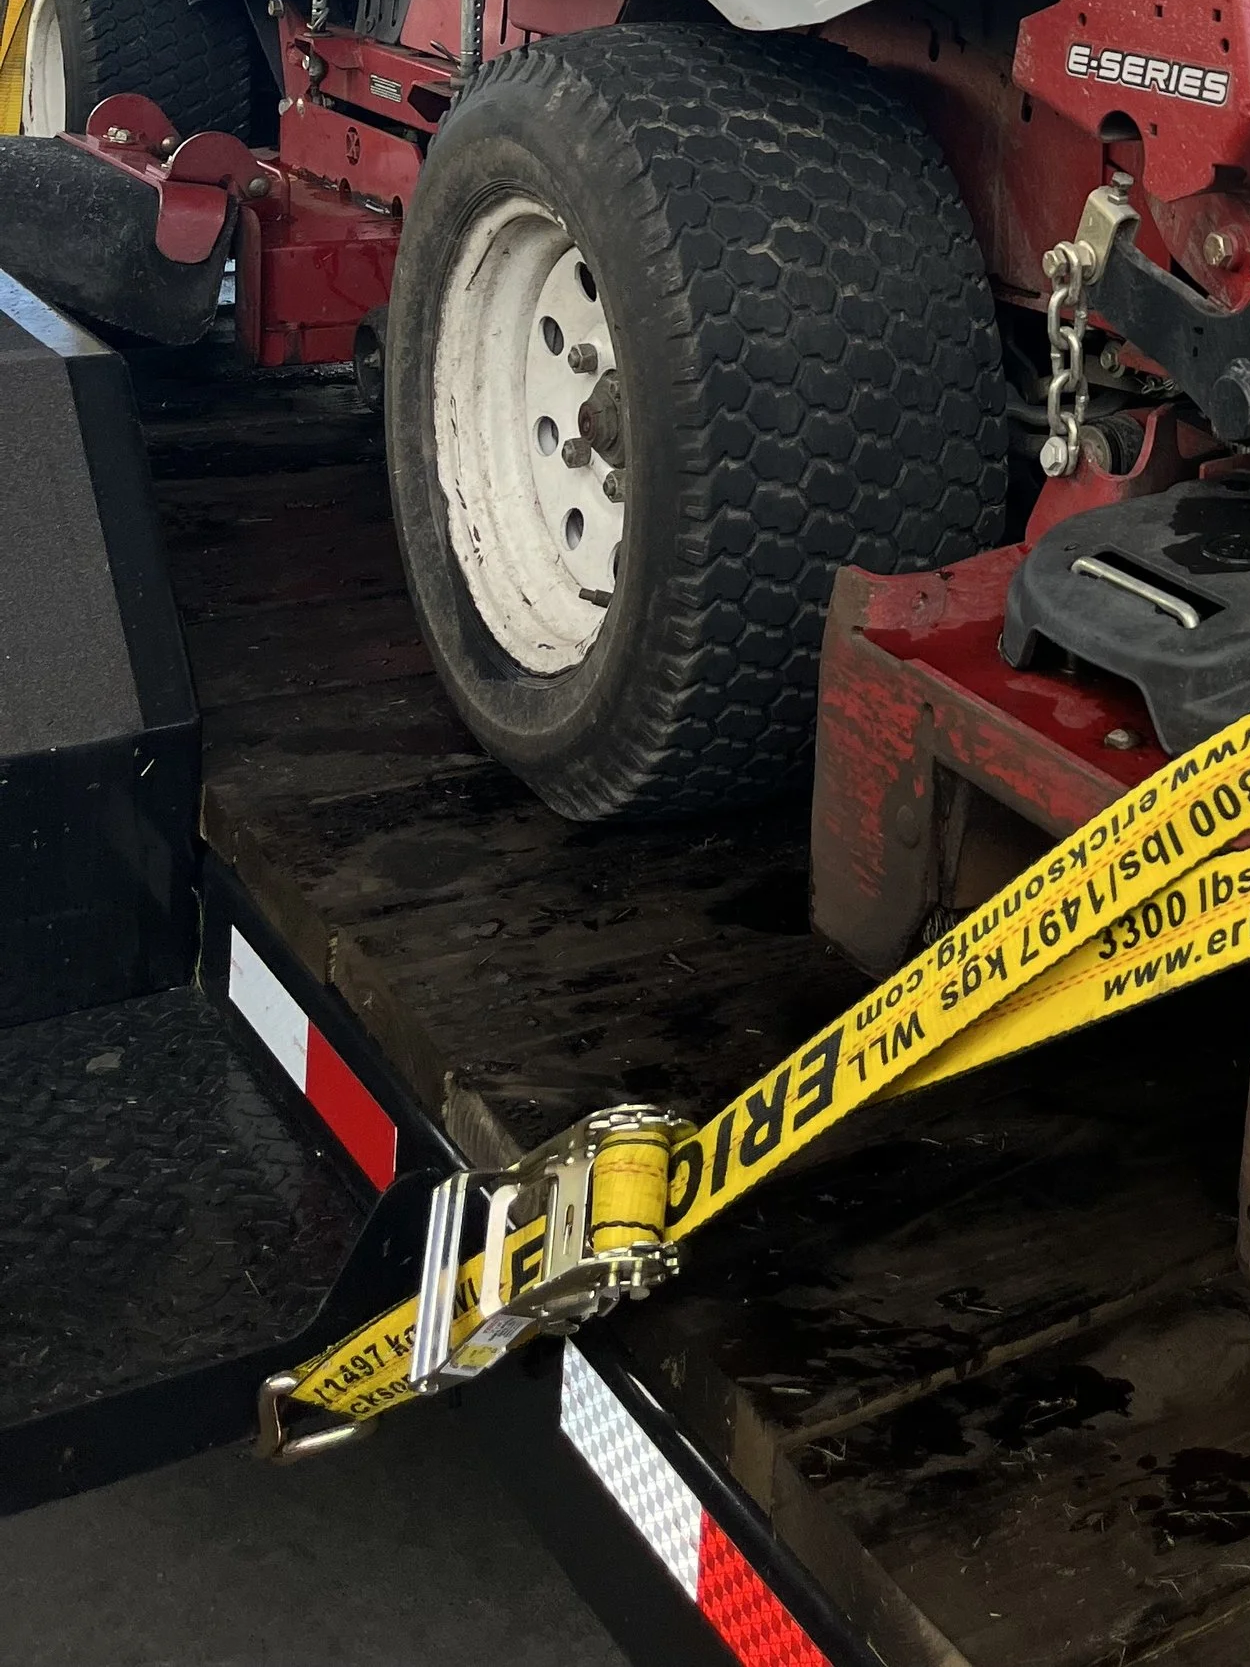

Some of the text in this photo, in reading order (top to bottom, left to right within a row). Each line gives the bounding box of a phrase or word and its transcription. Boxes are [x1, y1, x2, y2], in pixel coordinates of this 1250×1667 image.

[1068, 43, 1230, 104] E-SERIES
[1020, 821, 1185, 967] lbs/1497
[1098, 890, 1187, 960] 3300
[941, 946, 1008, 1011] kgs
[847, 1011, 926, 1082] WLL
